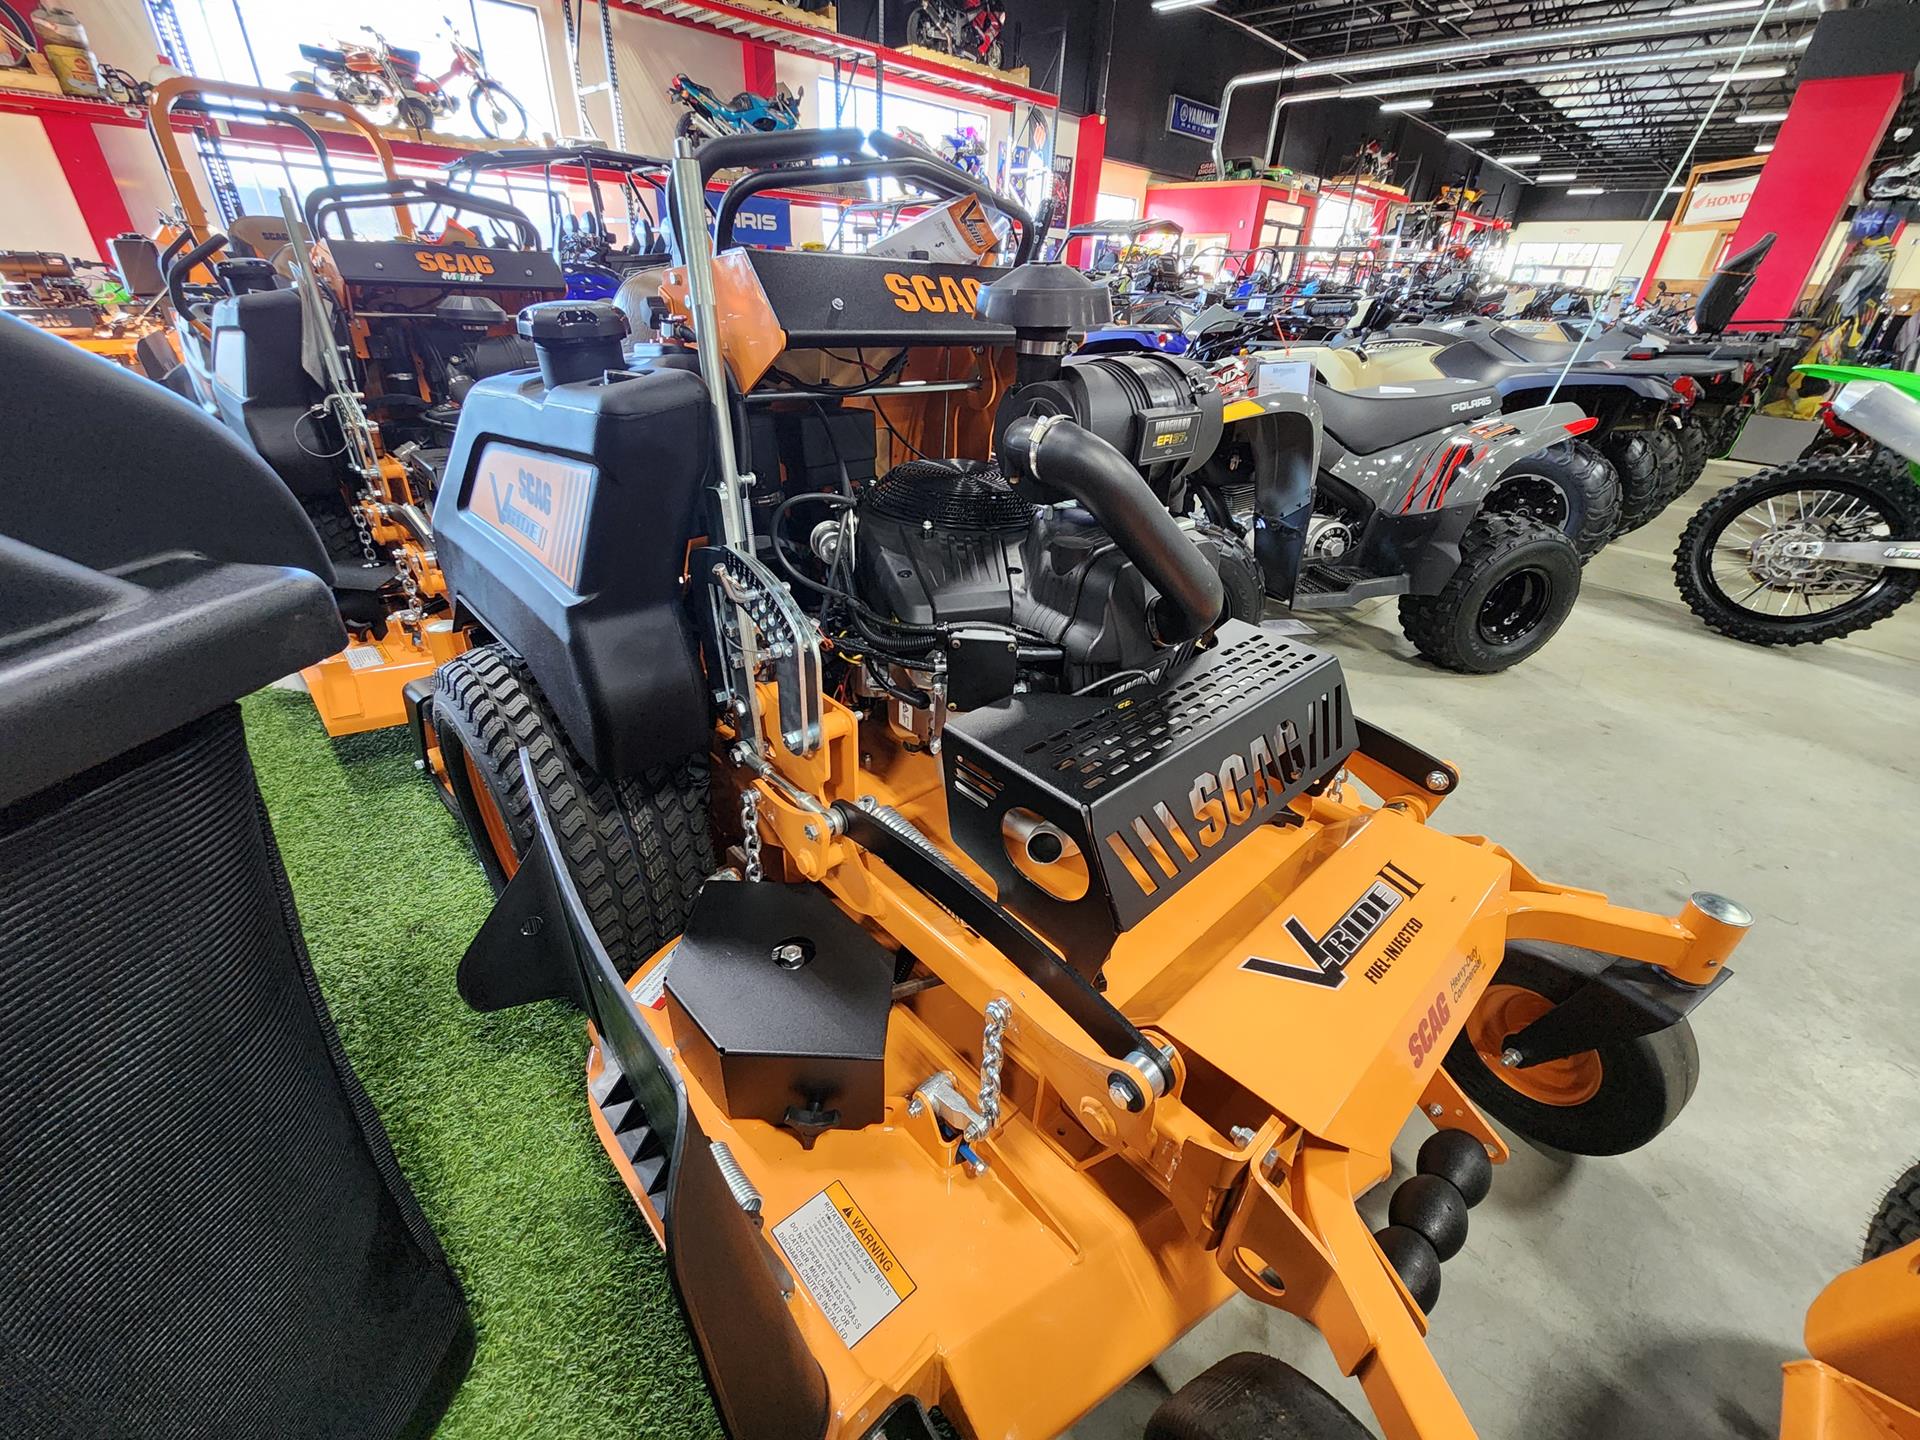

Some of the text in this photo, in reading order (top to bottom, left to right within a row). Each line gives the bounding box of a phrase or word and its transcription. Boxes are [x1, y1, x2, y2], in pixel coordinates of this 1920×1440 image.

[1188, 106, 1215, 127] YAMAHA
[1706, 193, 1750, 208] HOND
[414, 250, 495, 275] SCAG
[1365, 341, 1423, 350] KODIAK
[1451, 396, 1492, 413] POLARIS
[518, 466, 552, 516] SCAG
[1189, 718, 1306, 848] SCAG
[1363, 917, 1425, 986] FUEL-INJECTED
[1408, 991, 1451, 1069] SCAG
[823, 1201, 892, 1296] ROTATING BLADES AND BELTS
[852, 1216, 893, 1272] WARNING
[778, 1232, 849, 1340] DISCHARGE CHUTE IS INSTALLED
[789, 1221, 862, 1330] DO NOT OPERATE UNLESS GRASS
[807, 1265, 835, 1303] MULCHING
[831, 1301, 843, 1314] KIT
[840, 1314, 850, 1328] OR
